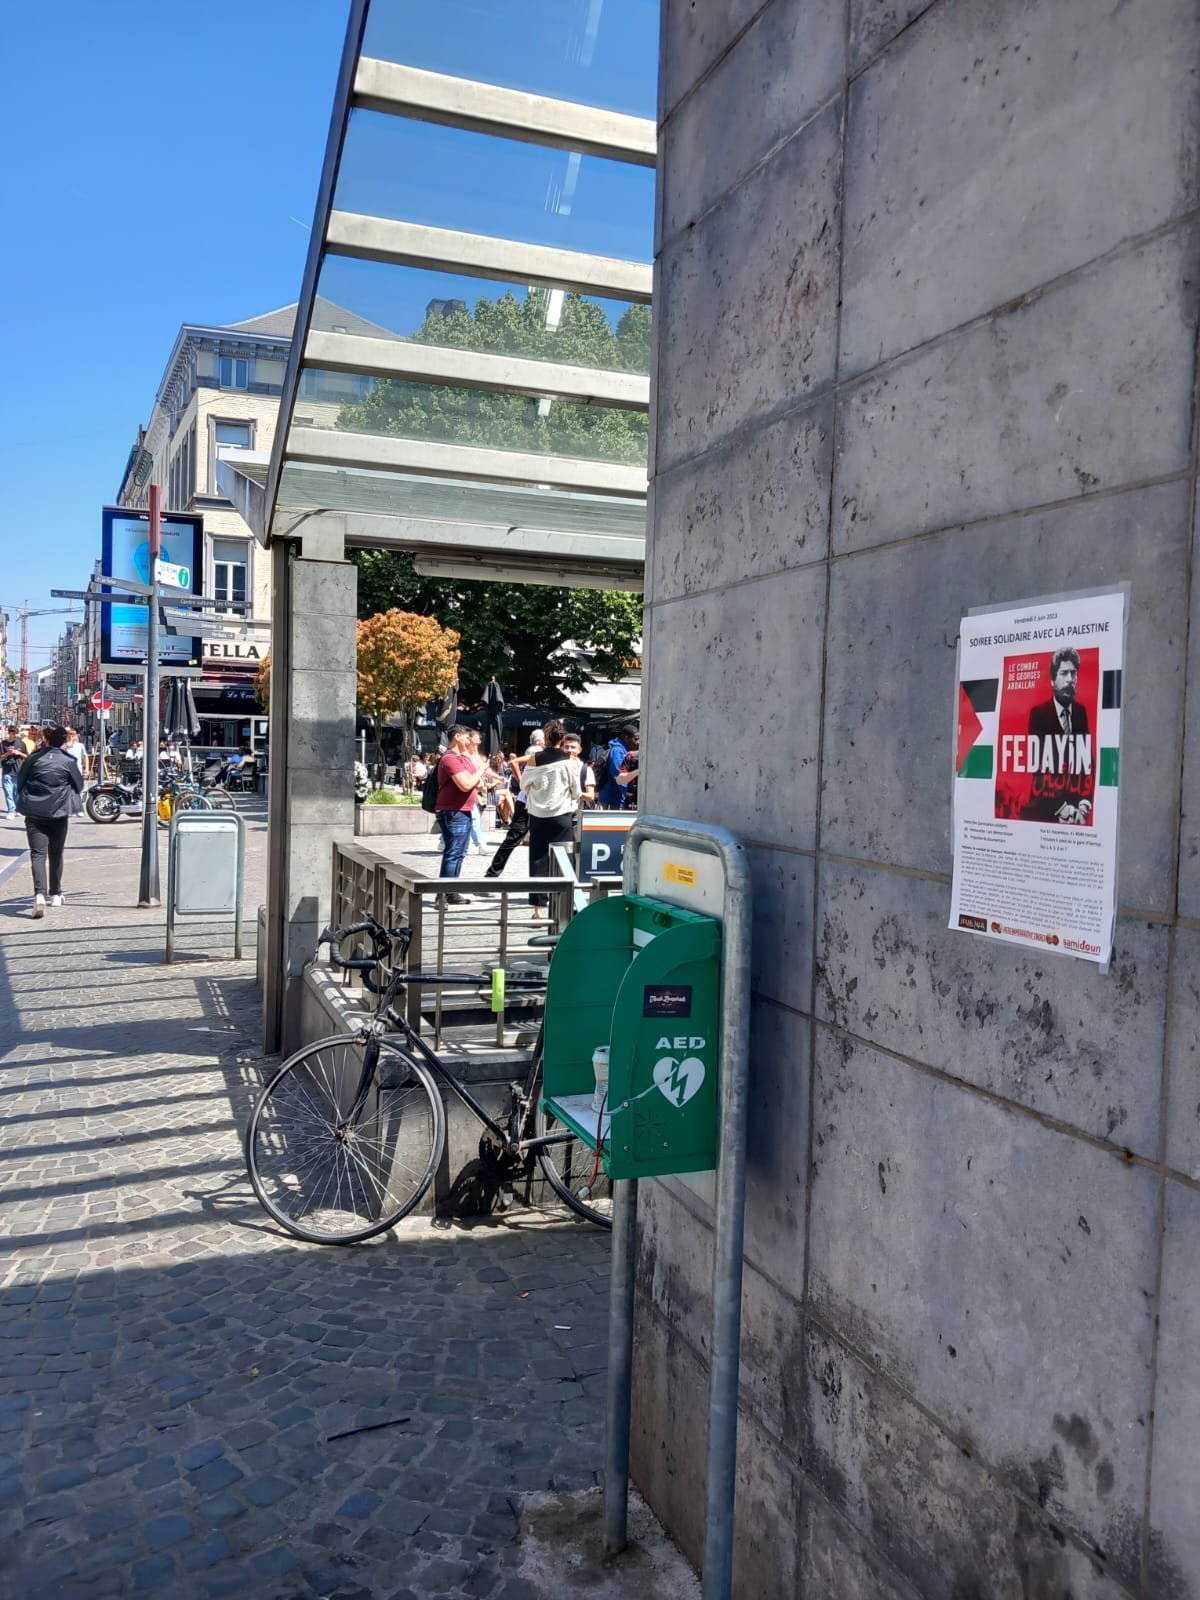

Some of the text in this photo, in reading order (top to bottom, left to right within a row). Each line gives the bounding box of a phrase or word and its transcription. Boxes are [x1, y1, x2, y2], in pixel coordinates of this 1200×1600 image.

[969, 622, 1110, 648] SOIREE SOLIDAIRE AVEC LA PALESTINE
[202, 643, 260, 659] TELLA
[1008, 661, 1038, 672] LE COMBAT
[1008, 671, 1041, 681] DE GEORGES
[1007, 682, 1036, 691] ABDALLAH
[591, 843, 611, 870] P
[1062, 939, 1101, 953] samidoun
[655, 1036, 706, 1049] AED
